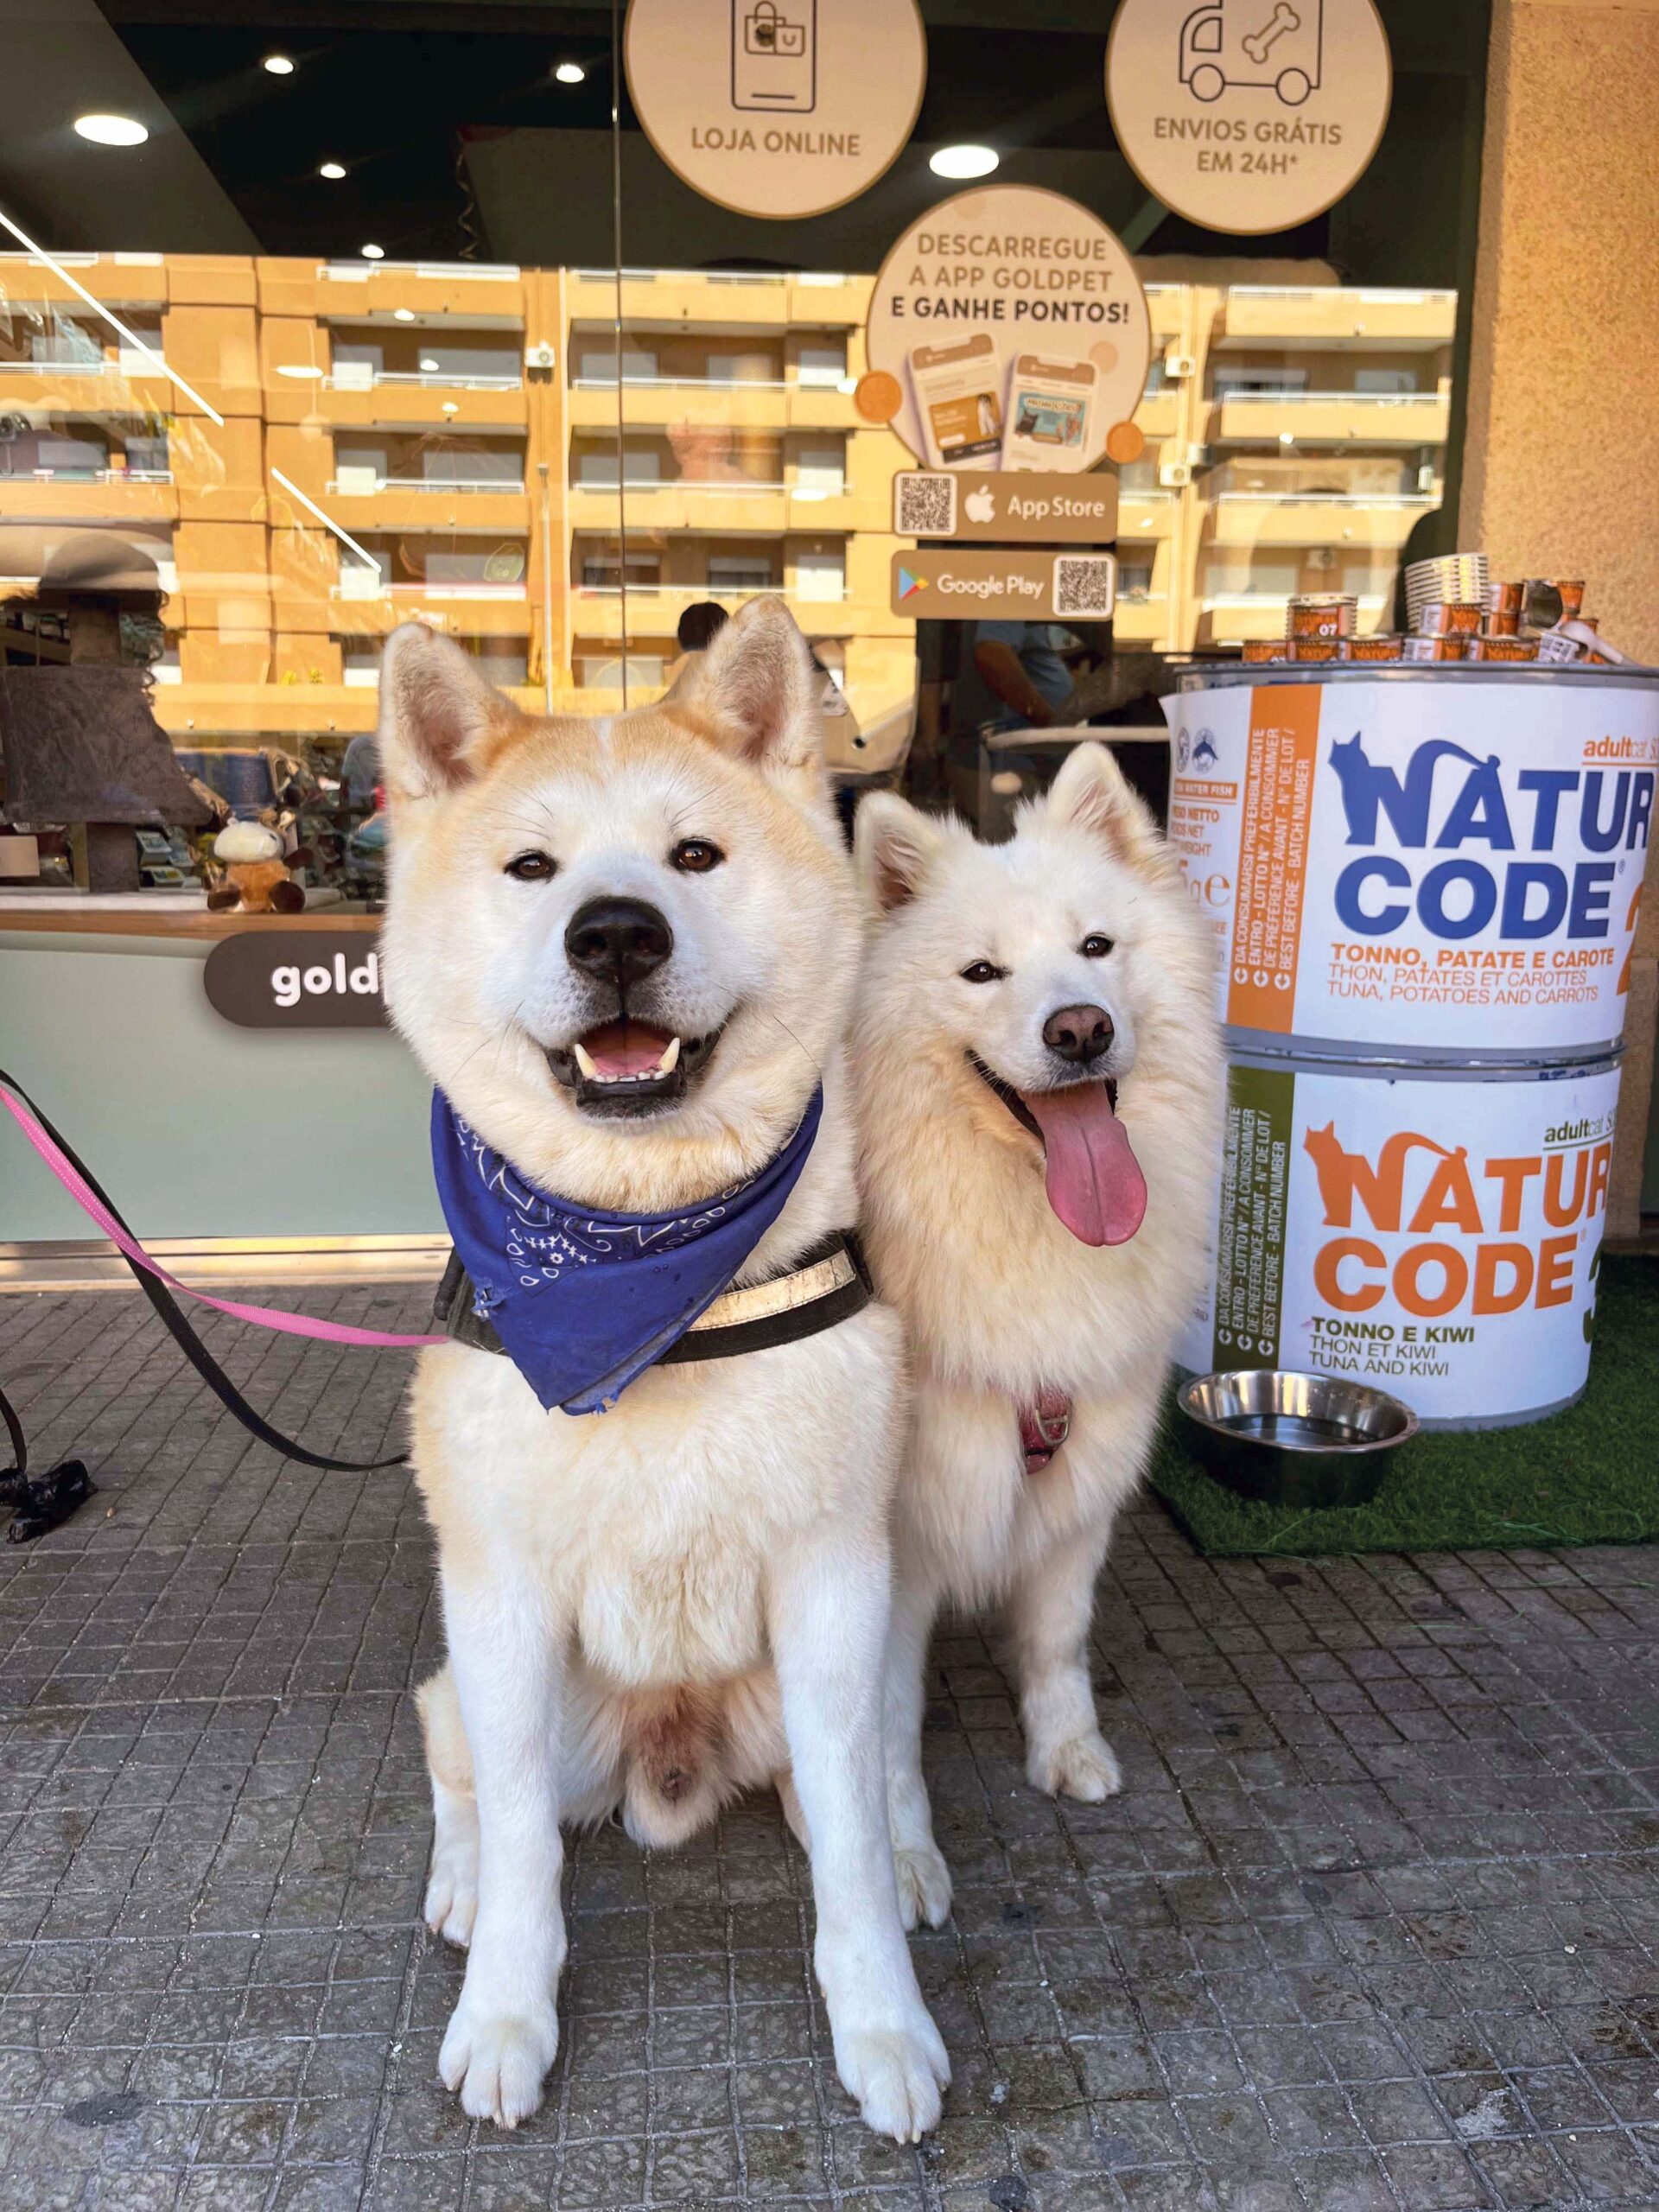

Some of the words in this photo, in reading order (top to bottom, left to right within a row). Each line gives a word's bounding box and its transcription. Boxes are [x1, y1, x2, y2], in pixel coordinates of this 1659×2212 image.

[691, 127, 756, 151] LOJA
[764, 130, 861, 156] ONLINE
[1154, 117, 1247, 141] ENVIOS
[1255, 116, 1342, 145] GRÁTIS
[1197, 150, 1233, 173] EM
[917, 232, 1106, 260] DESCARREGUE
[909, 264, 926, 286] A
[934, 265, 985, 288] APP
[994, 267, 1113, 292] GOLDPET
[891, 296, 905, 318] E
[913, 296, 1006, 320] GANHE
[1014, 299, 1129, 324] PONTOS!
[1007, 495, 1051, 521] App
[1052, 496, 1106, 518] Store
[937, 573, 1004, 600] Google
[1007, 575, 1046, 600] Play
[1319, 623, 1338, 636] 07
[1281, 737, 1295, 764] LOT
[1261, 728, 1280, 821] CONSOMMER
[1278, 766, 1293, 785] DE
[1244, 728, 1264, 852] PREFERIBILMENTE
[1292, 760, 1311, 820] NUMBER
[1188, 807, 1220, 823] NETTO
[1273, 816, 1287, 861] AVANT
[1287, 823, 1305, 868] BATCH
[1236, 853, 1254, 944] CONSUMARSI
[1253, 863, 1268, 909] LOTTO
[1282, 878, 1300, 933] BEFORE
[1235, 944, 1247, 963] DA
[1249, 919, 1263, 966] ENTRO
[1279, 935, 1294, 970] BEST
[1263, 949, 1275, 969] DE
[1331, 943, 1427, 971] TONNO,
[1437, 948, 1525, 969] PATATE
[1532, 949, 1546, 969] E
[1552, 947, 1614, 969] CAROTE
[272, 952, 386, 1007] gold
[1329, 963, 1387, 984] THON,
[1394, 966, 1478, 988] PATATES
[1481, 969, 1503, 988] ET
[1507, 969, 1588, 988] CAROTTES
[1327, 981, 1383, 1002] TUNA,
[1389, 983, 1491, 1005] POTATOES
[1494, 987, 1532, 1005] AND
[1535, 986, 1599, 1004] CARROTS
[1257, 1118, 1271, 1146] LOT
[1239, 1108, 1255, 1195] CONSOMMER
[1255, 1146, 1269, 1164] DE
[1270, 1141, 1286, 1199] NUMBER
[1252, 1192, 1266, 1234] AVANT
[1268, 1199, 1282, 1243] BATCH
[1235, 1234, 1249, 1278] LOTTO
[1264, 1251, 1280, 1303] BEFORE
[1232, 1286, 1245, 1331] ENTRO
[1262, 1304, 1276, 1338] BEST
[1246, 1316, 1259, 1335] DE
[1311, 1315, 1395, 1341] TONNO
[1403, 1326, 1417, 1342] E
[1425, 1326, 1475, 1342] KIWI
[1309, 1334, 1362, 1356] THON
[1368, 1343, 1391, 1357] ET
[1396, 1344, 1437, 1359] KIWI
[1308, 1351, 1358, 1370] TUNA
[1363, 1358, 1405, 1376] AND
[1410, 1362, 1450, 1376] KIWI
